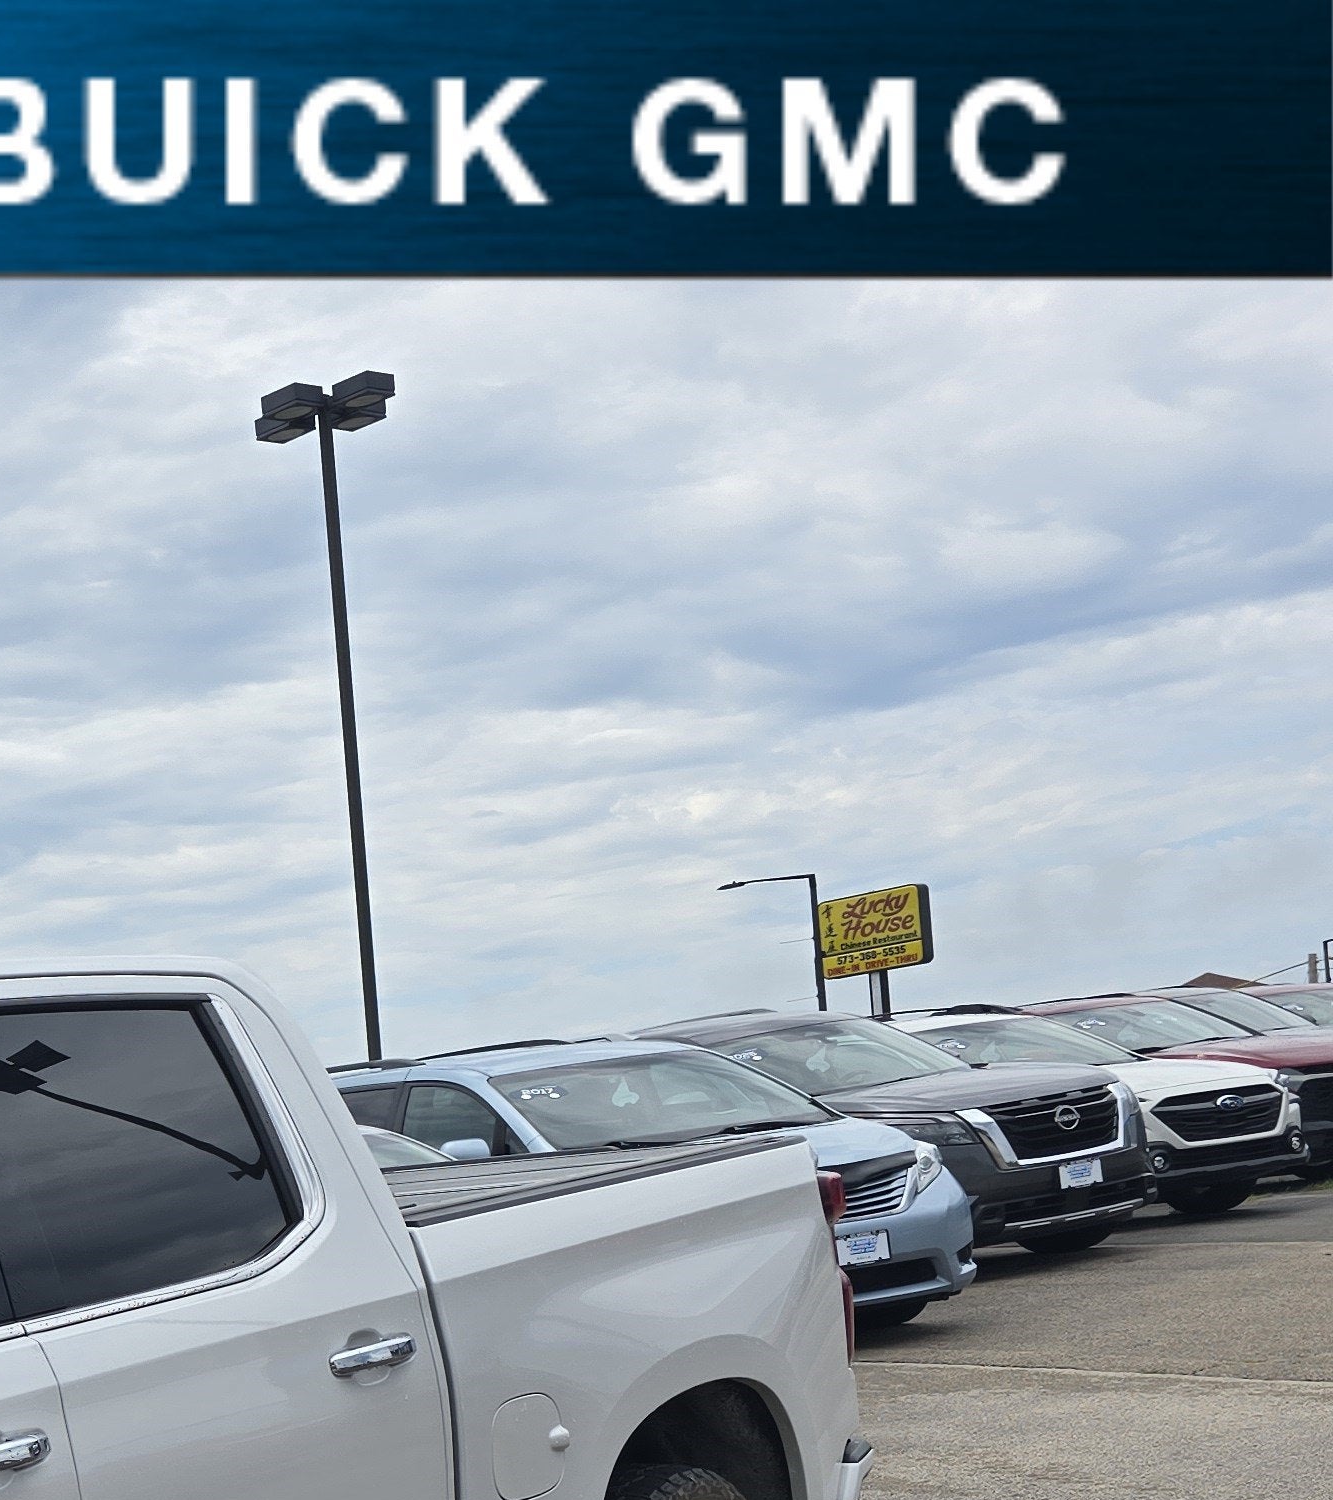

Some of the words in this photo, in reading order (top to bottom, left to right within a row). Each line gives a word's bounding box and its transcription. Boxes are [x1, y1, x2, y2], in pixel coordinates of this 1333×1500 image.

[842, 892, 909, 918] Lucky
[841, 914, 915, 940] House
[841, 939, 871, 951] Chinese
[873, 929, 918, 945] Restaurant
[827, 963, 860, 978] DINE-IN
[865, 953, 918, 970] DRIVE-THRU
